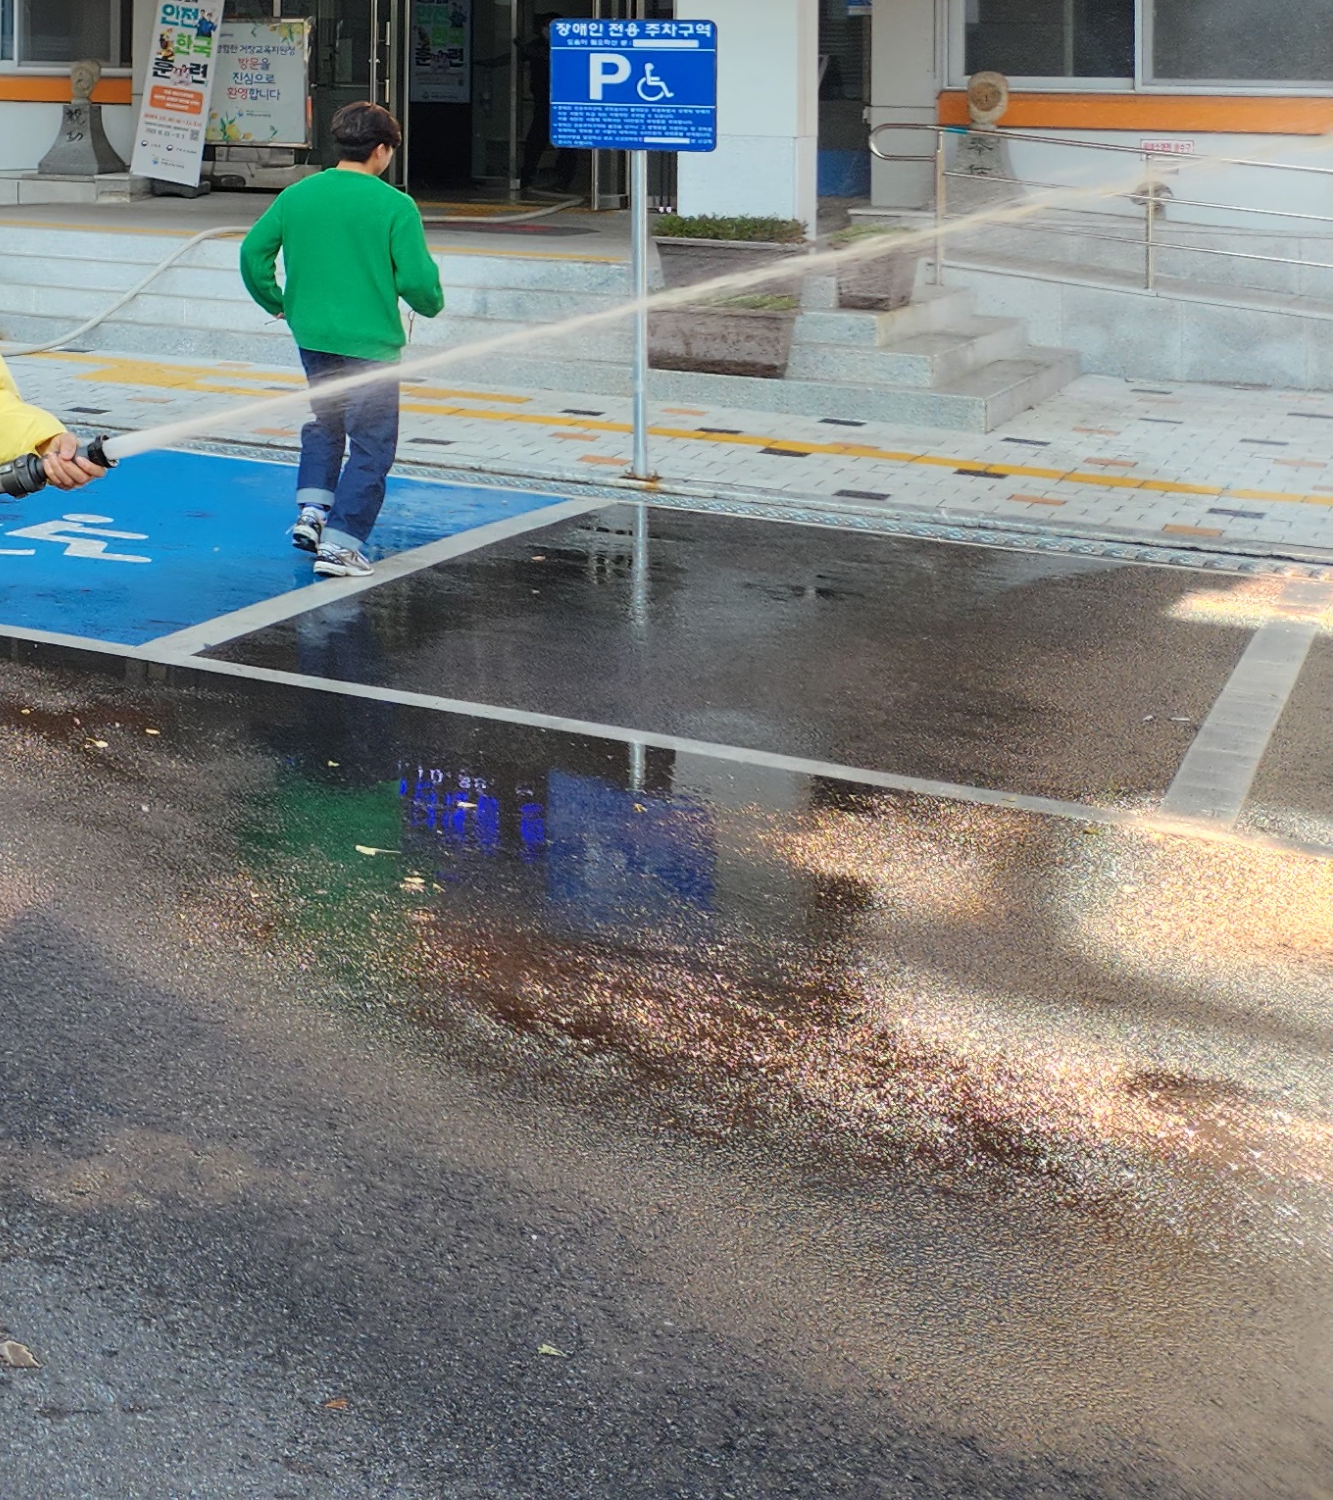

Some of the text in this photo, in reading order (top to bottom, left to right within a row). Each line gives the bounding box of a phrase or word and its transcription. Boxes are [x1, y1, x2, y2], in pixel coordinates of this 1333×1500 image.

[161, 3, 200, 28] 안전
[555, 22, 712, 38] 장애인 전용 주차구역
[174, 31, 213, 58] 한국
[152, 57, 209, 84] 훈련
[238, 57, 270, 71] 방문을
[232, 71, 276, 85] 진심으로
[589, 52, 632, 100] P
[227, 86, 281, 100] 환영합니다
